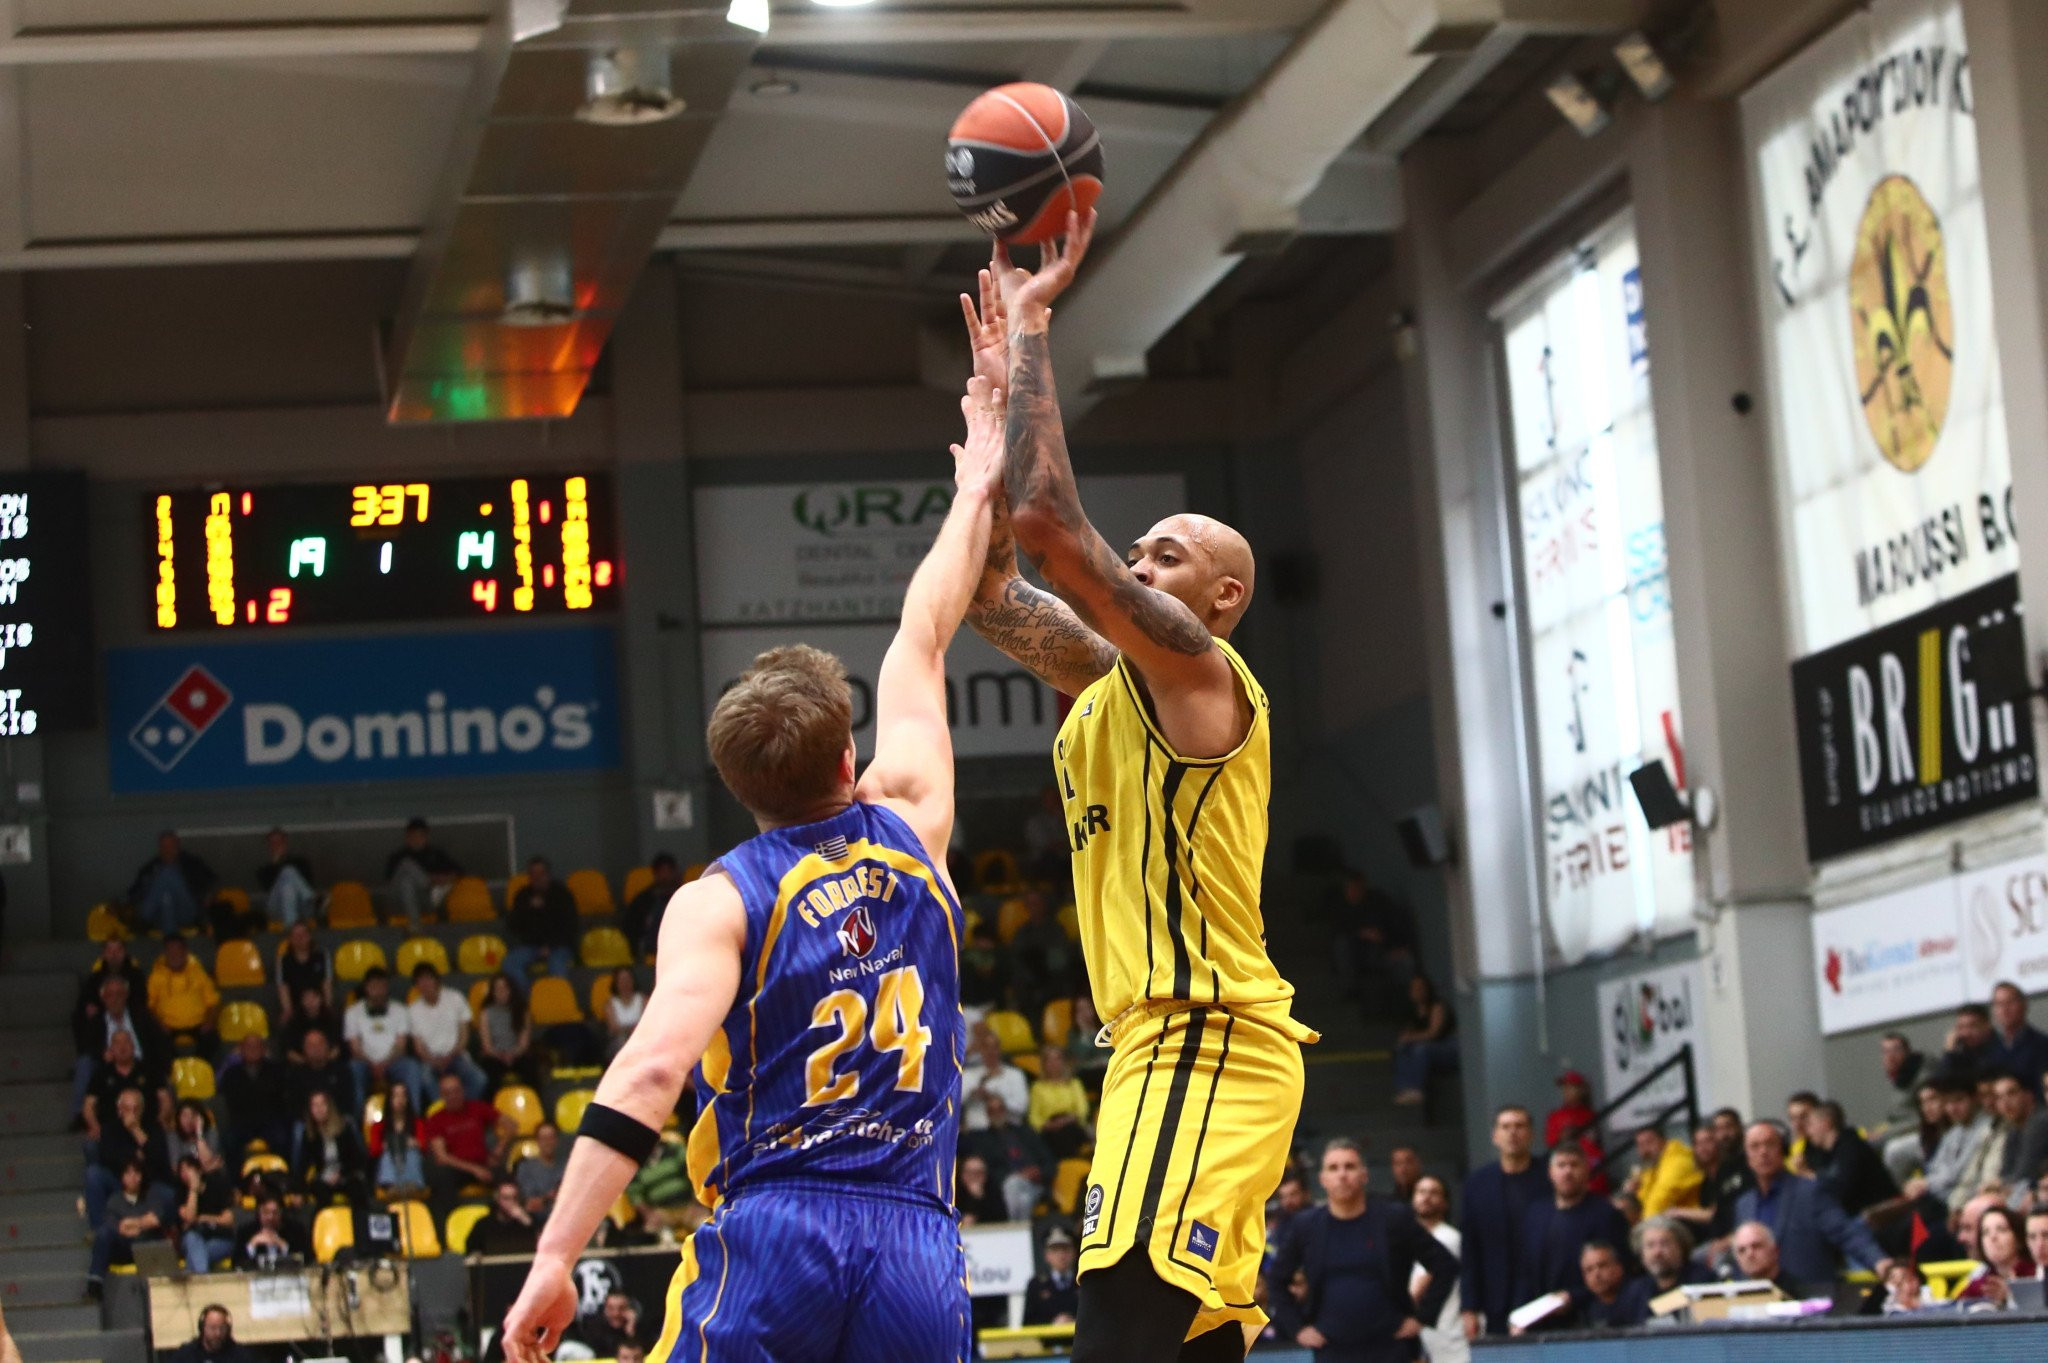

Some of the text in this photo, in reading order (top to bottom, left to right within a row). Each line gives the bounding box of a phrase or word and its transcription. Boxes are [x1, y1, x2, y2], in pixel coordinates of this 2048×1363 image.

[289, 537, 326, 578] 19
[457, 530, 495, 571] 14
[472, 579, 498, 612] 4
[242, 685, 593, 765] Domino's
[797, 866, 899, 928] FORREST
[860, 944, 903, 976] Naval
[801, 966, 932, 1108] 24
